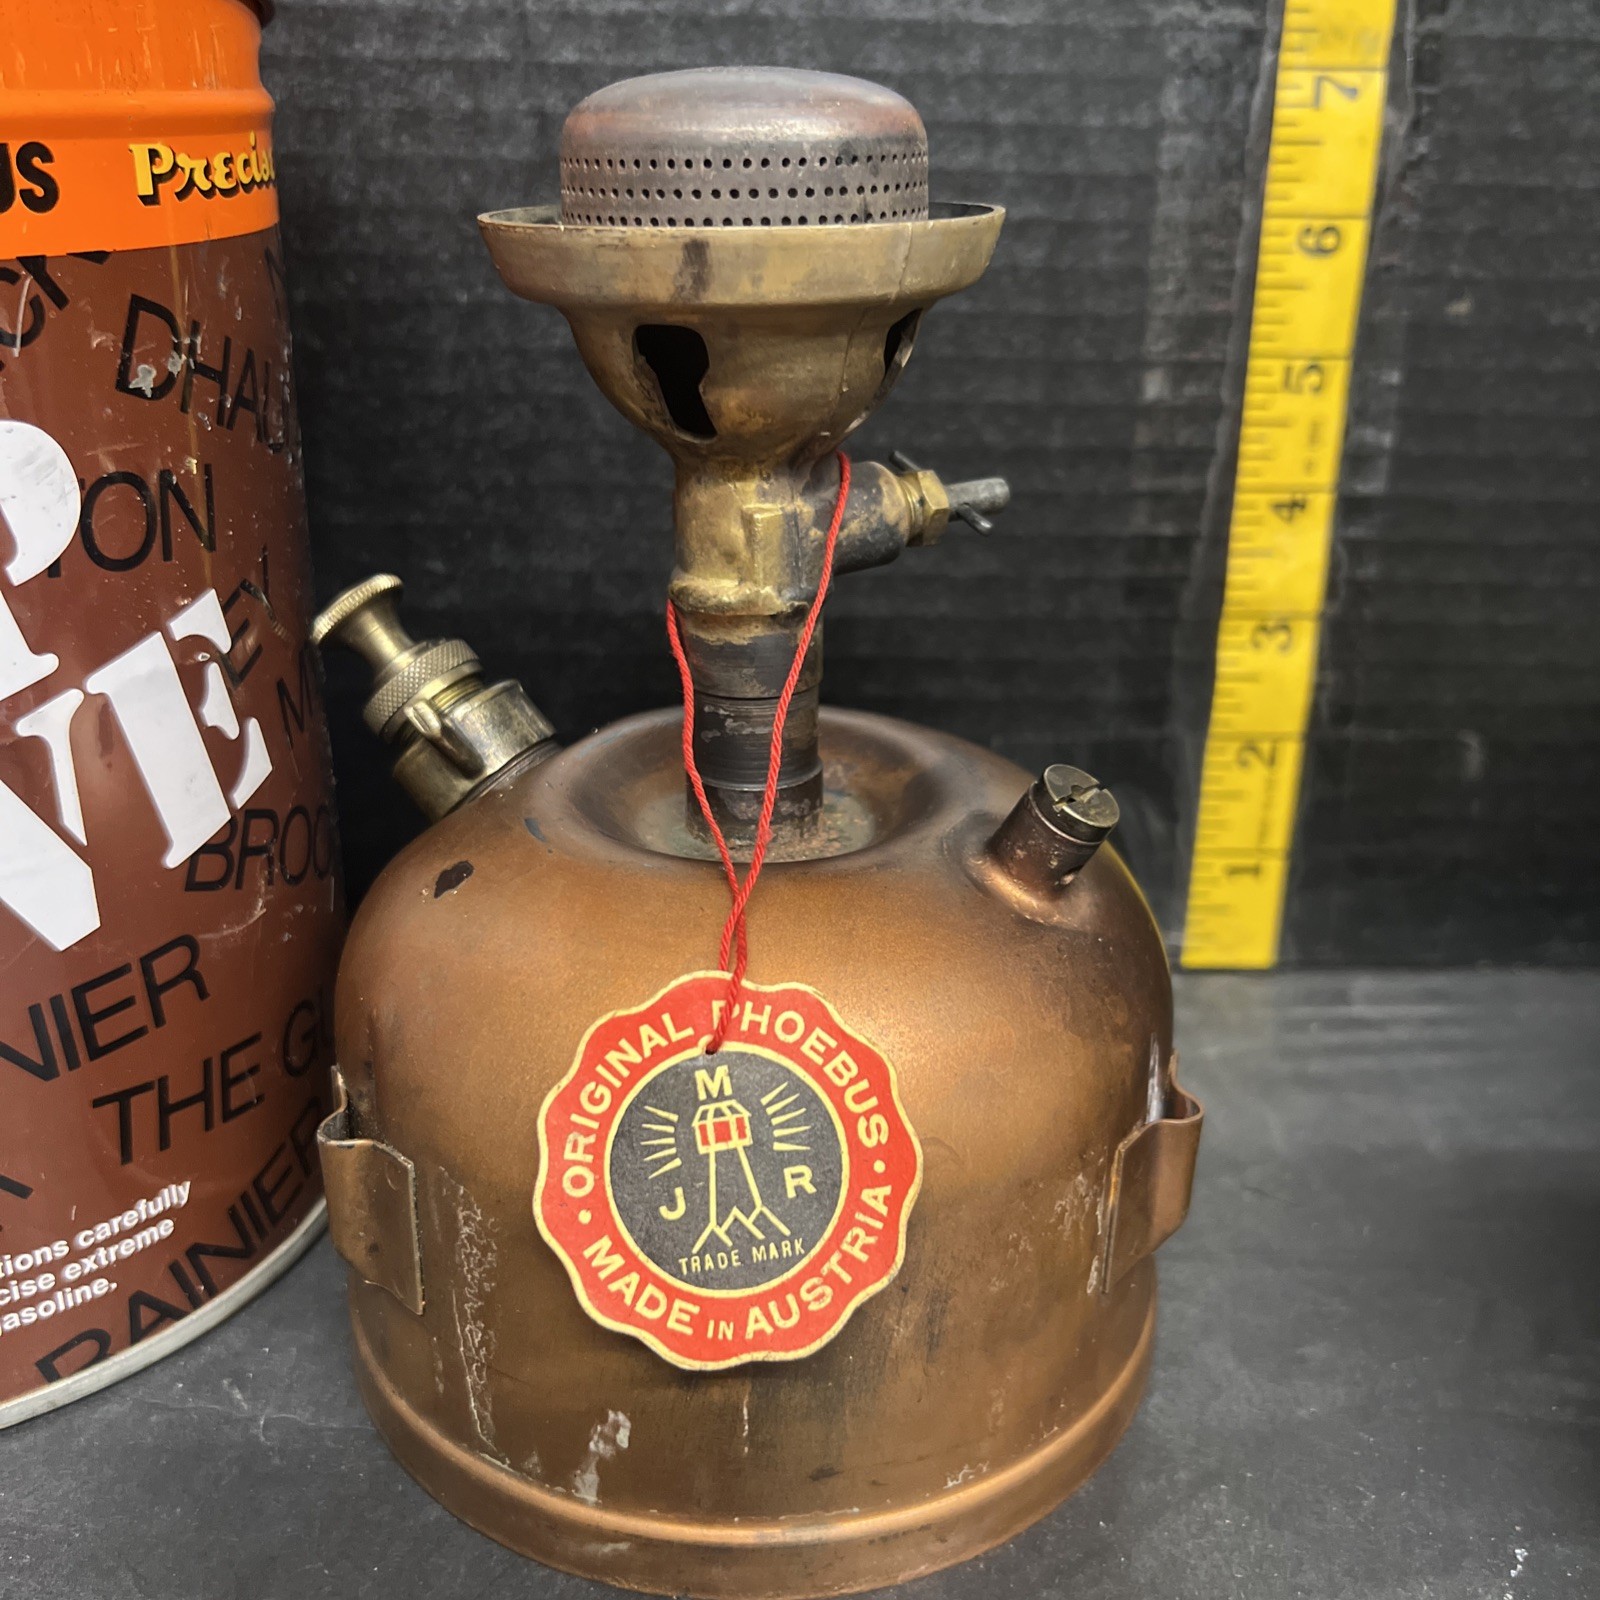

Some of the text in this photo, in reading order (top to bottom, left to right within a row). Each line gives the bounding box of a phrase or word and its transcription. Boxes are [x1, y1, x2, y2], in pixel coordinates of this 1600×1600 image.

[1313, 75, 1358, 110] 7
[1299, 224, 1341, 258] 6
[1283, 363, 1324, 394] 5
[1270, 494, 1307, 523] 4
[1251, 619, 1294, 652] 3
[1236, 740, 1276, 768] 2
[1226, 862, 1261, 881] 1
[93, 1031, 264, 1165] THE
[562, 999, 890, 1198] ORIGINAL PHOEBUS
[694, 1064, 734, 1101] M
[783, 1164, 817, 1199] R
[73, 1181, 191, 1249] carefully
[659, 1186, 687, 1220] J
[62, 1217, 175, 1280] extreme
[582, 1184, 892, 1341] MADE IN AUSTRIA
[679, 1237, 806, 1276] TRADE MARK
[0, 1277, 118, 1336] asoline.
